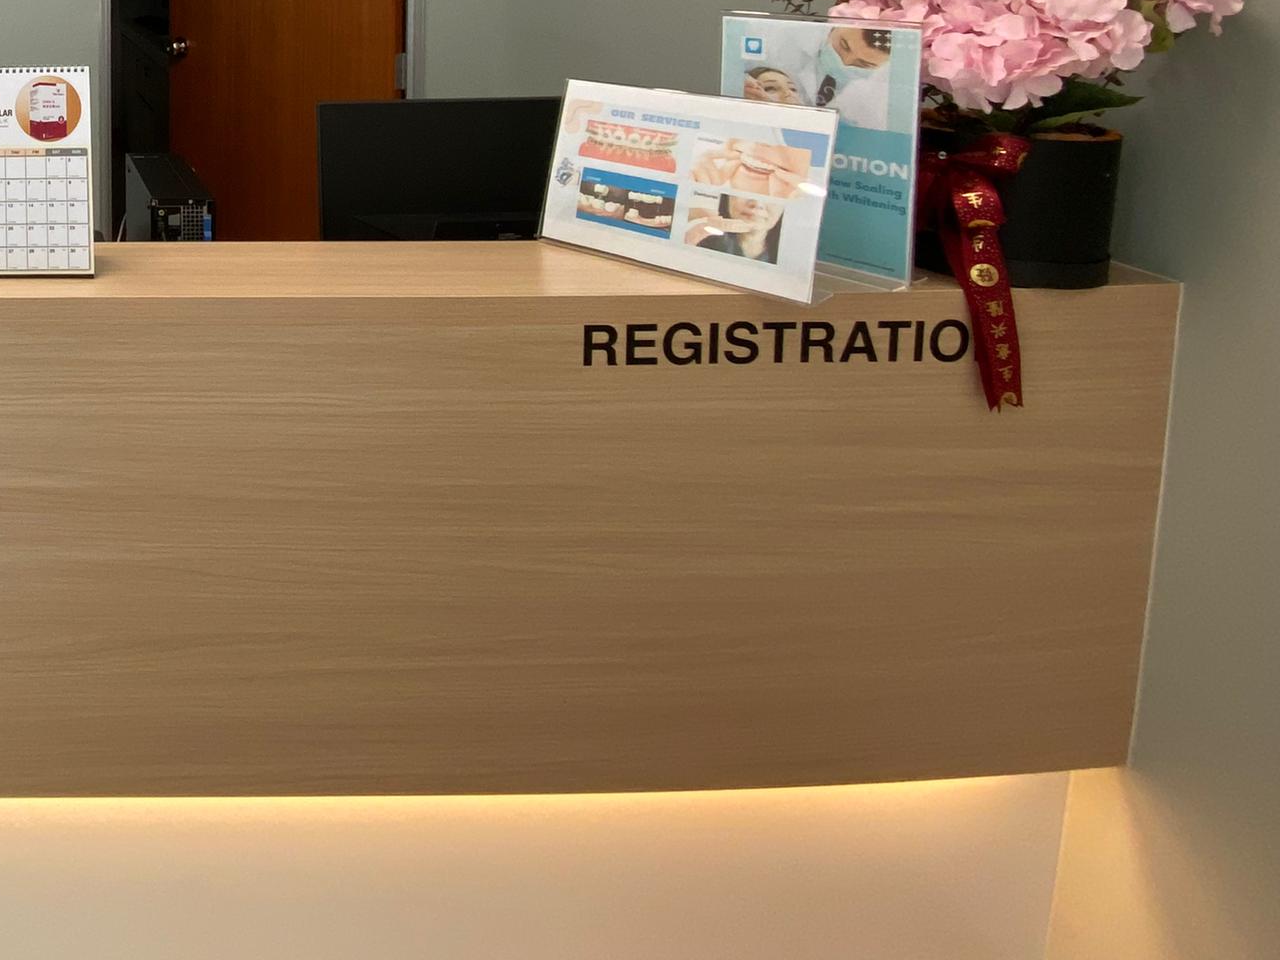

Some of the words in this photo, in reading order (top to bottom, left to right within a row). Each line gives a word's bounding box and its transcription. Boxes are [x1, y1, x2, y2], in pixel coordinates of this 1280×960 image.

[611, 109, 635, 120] OUR
[641, 113, 700, 129] SERVICES
[832, 153, 909, 180] OTION
[855, 181, 903, 200] Scaling
[842, 193, 907, 216] Whitening
[582, 319, 974, 366] REGISTRATIO
